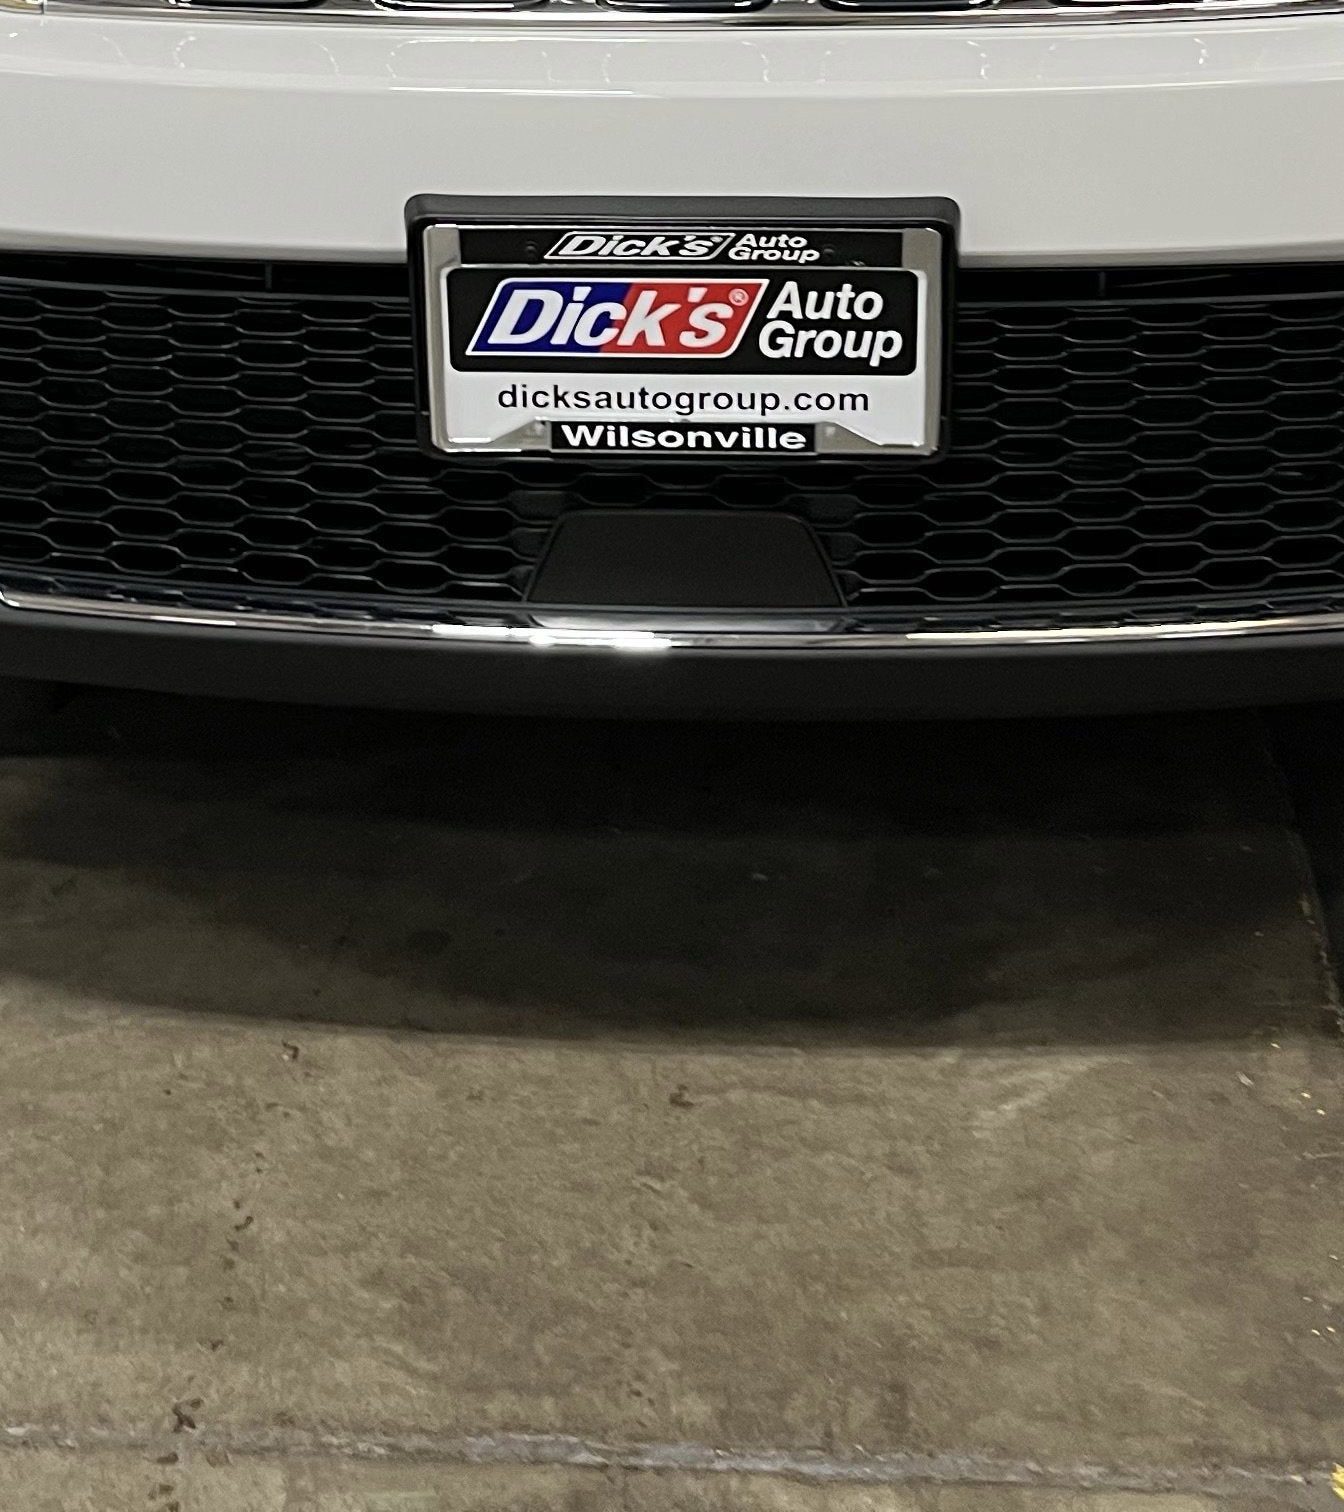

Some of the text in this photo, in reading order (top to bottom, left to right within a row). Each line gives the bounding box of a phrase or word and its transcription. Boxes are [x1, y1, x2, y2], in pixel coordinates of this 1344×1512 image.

[558, 233, 714, 256] Dick's
[728, 246, 821, 264] Group
[734, 233, 808, 248] Auto
[766, 280, 884, 320] Auto
[487, 285, 734, 348] Dick's
[758, 319, 904, 368] Group
[497, 384, 870, 416] dicksautogroup.com
[560, 424, 808, 451] Wilsonville
